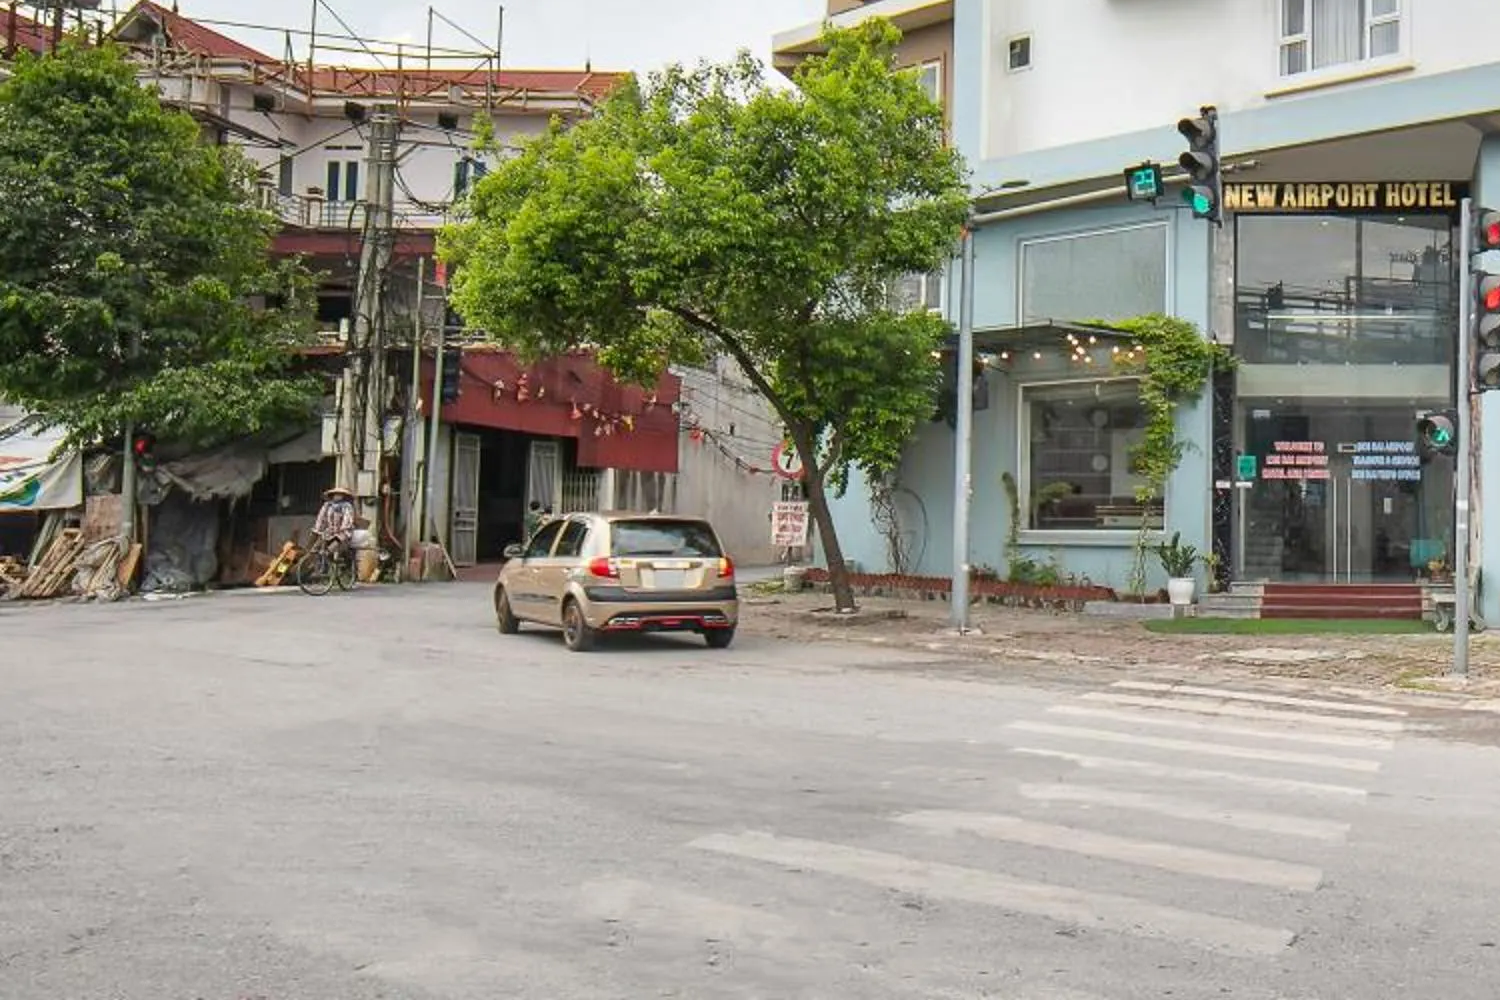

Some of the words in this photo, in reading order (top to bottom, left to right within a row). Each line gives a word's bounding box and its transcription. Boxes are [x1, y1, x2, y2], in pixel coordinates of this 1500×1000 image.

[1224, 183, 1278, 208] NEW
[1281, 183, 1379, 208] AIRPORT
[1385, 183, 1457, 208] HOTEL
